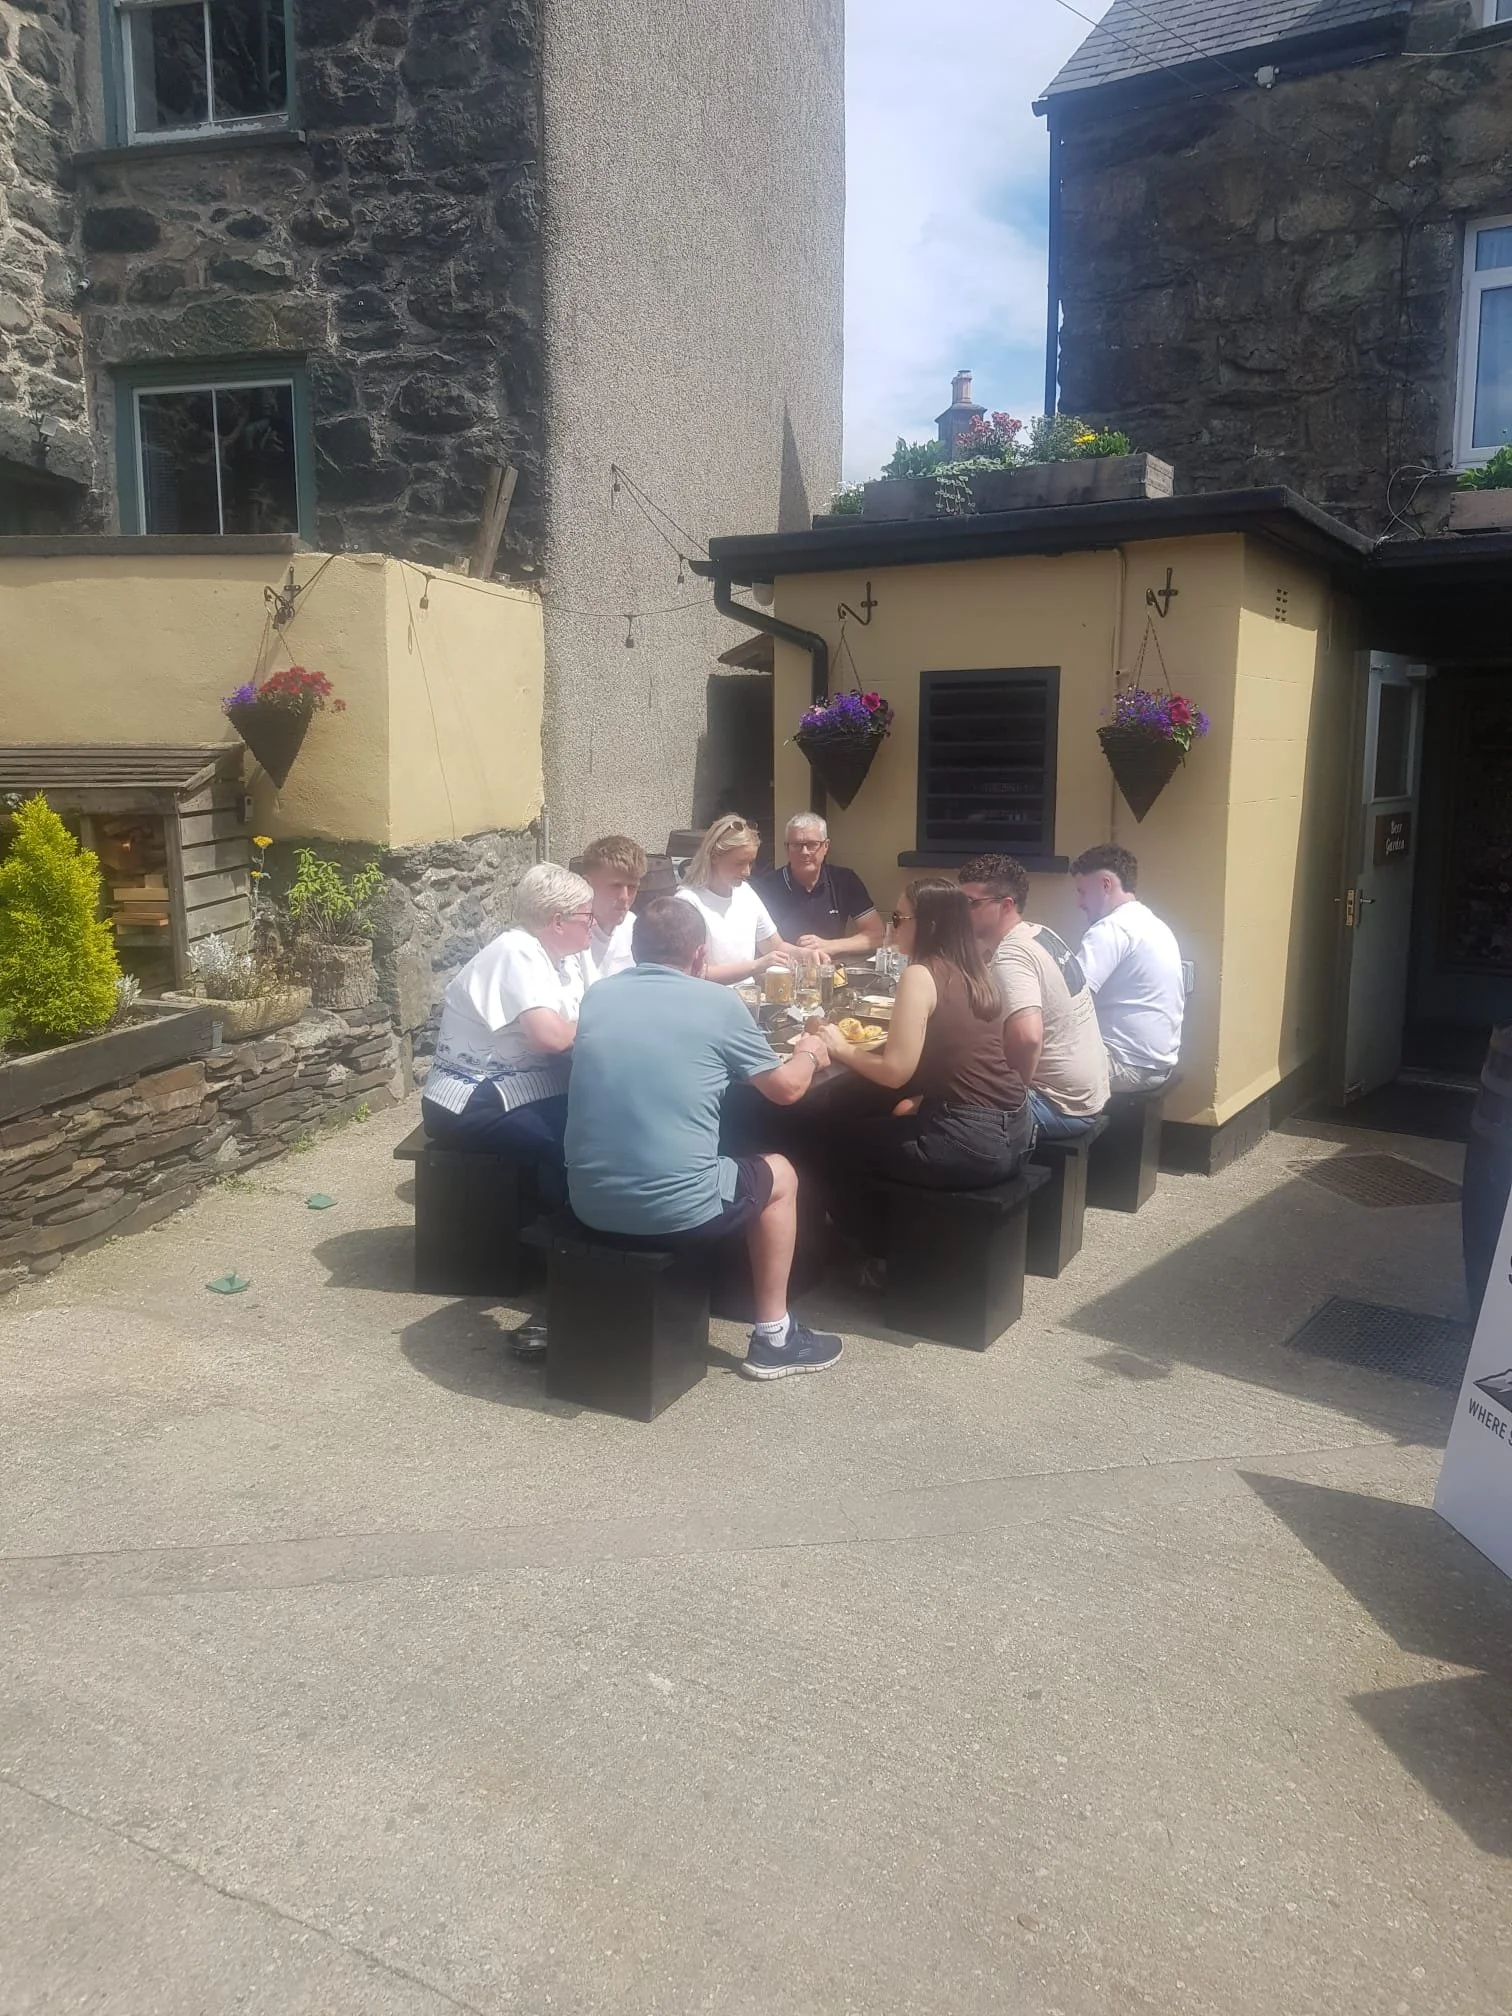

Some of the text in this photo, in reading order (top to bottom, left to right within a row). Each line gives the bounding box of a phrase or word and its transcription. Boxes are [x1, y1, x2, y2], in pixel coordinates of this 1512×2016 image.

[1391, 820, 1402, 834] Beer
[1385, 837, 1405, 856] Garden
[1469, 1398, 1507, 1439] WHERE
